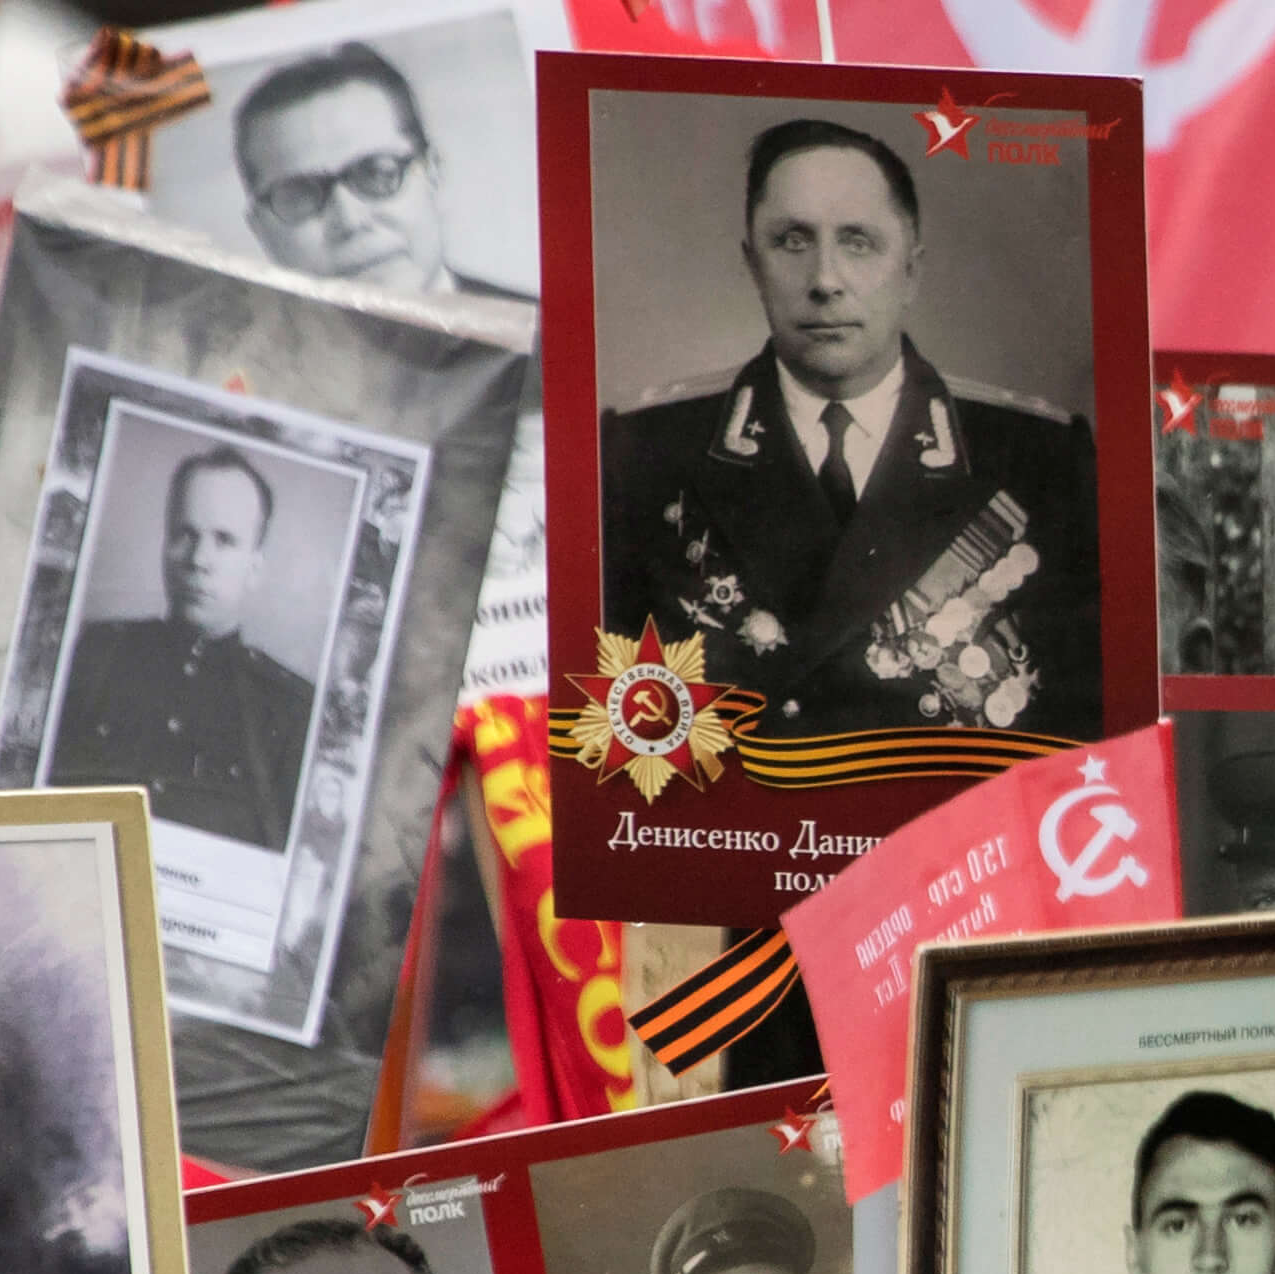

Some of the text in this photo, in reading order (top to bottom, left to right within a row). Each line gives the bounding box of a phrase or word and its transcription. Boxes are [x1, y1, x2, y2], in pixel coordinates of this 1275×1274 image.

[987, 140, 1062, 167] ПОЛК
[610, 667, 683, 745] ОТЕЧЕСТВЕННАЯ
[608, 812, 780, 852] Денисенко
[774, 870, 838, 892] пол
[1138, 1024, 1275, 1049] БЕССМЕРТНЫЙ ПОЛК
[409, 1201, 466, 1226] ПОЛК
